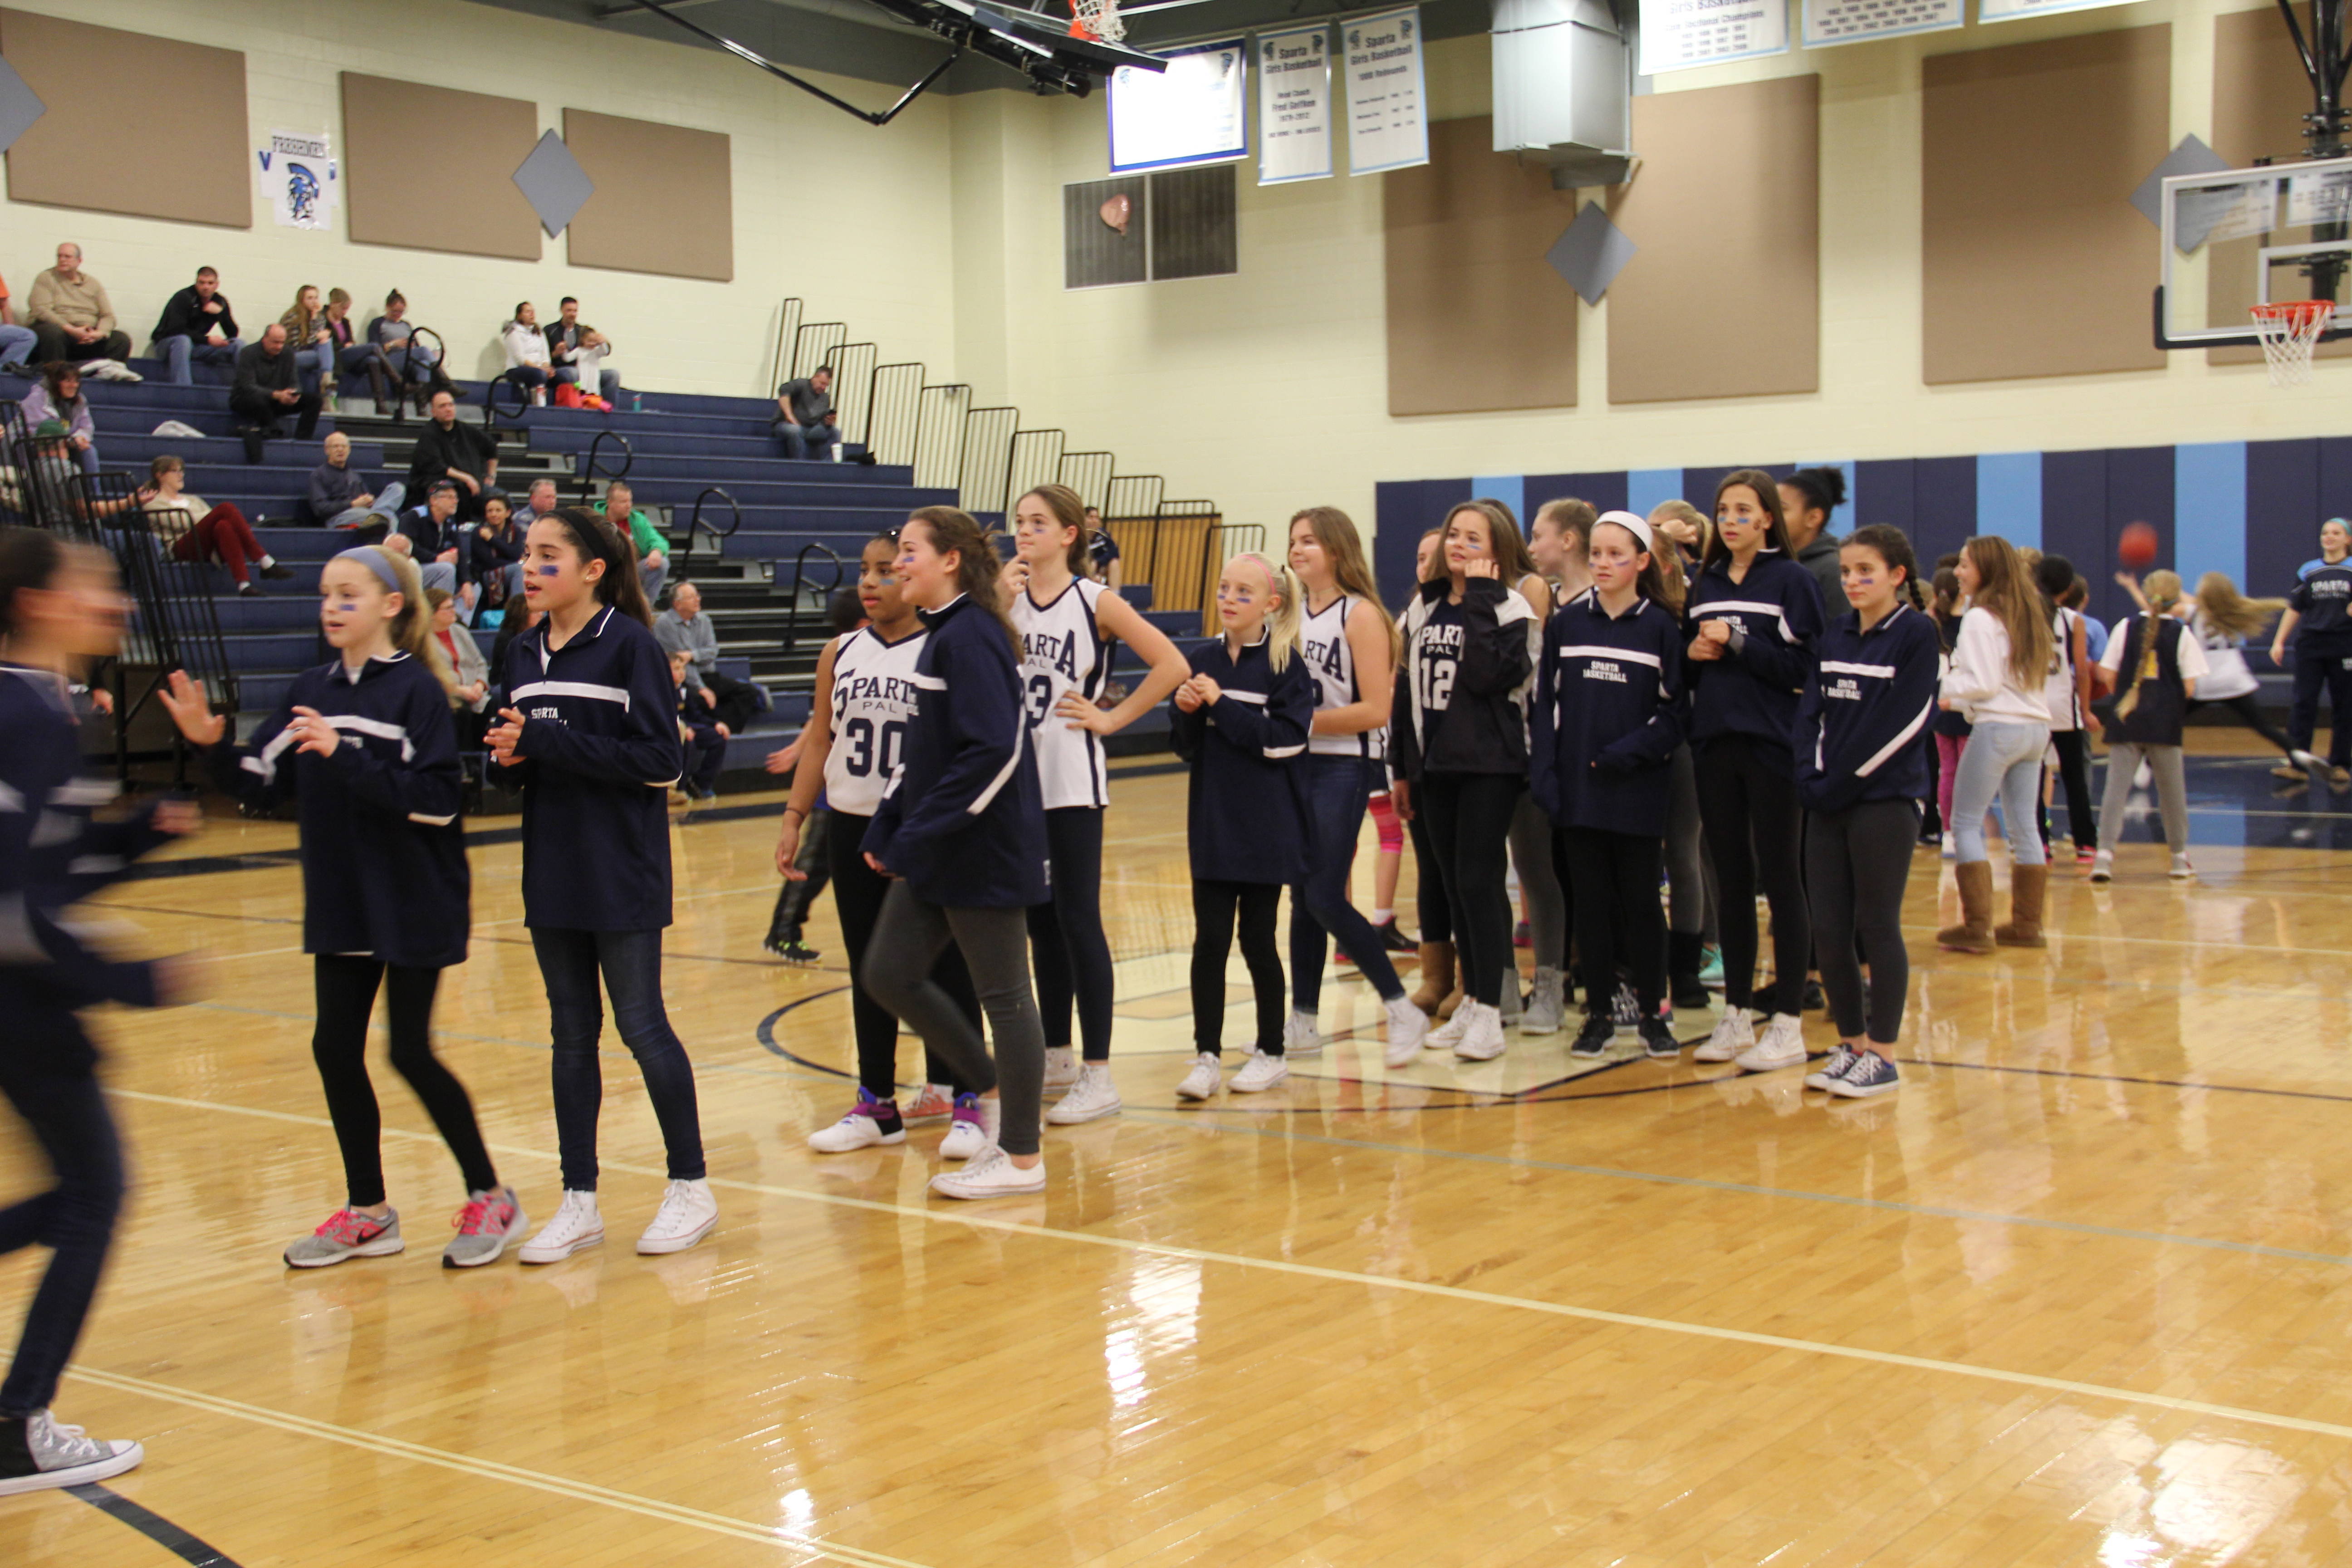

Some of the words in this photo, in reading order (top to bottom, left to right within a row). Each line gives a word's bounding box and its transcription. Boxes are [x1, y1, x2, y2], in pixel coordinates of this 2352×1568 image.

[1366, 34, 1396, 48] Sparta
[1279, 47, 1307, 59] Sparta
[1426, 645, 1453, 655] PAL
[1027, 658, 1046, 669] AL
[1591, 660, 1619, 672] SPARTA
[1421, 657, 1457, 711] 12
[833, 668, 915, 722] SPART
[862, 701, 897, 714] PAL
[846, 717, 908, 779] 30
